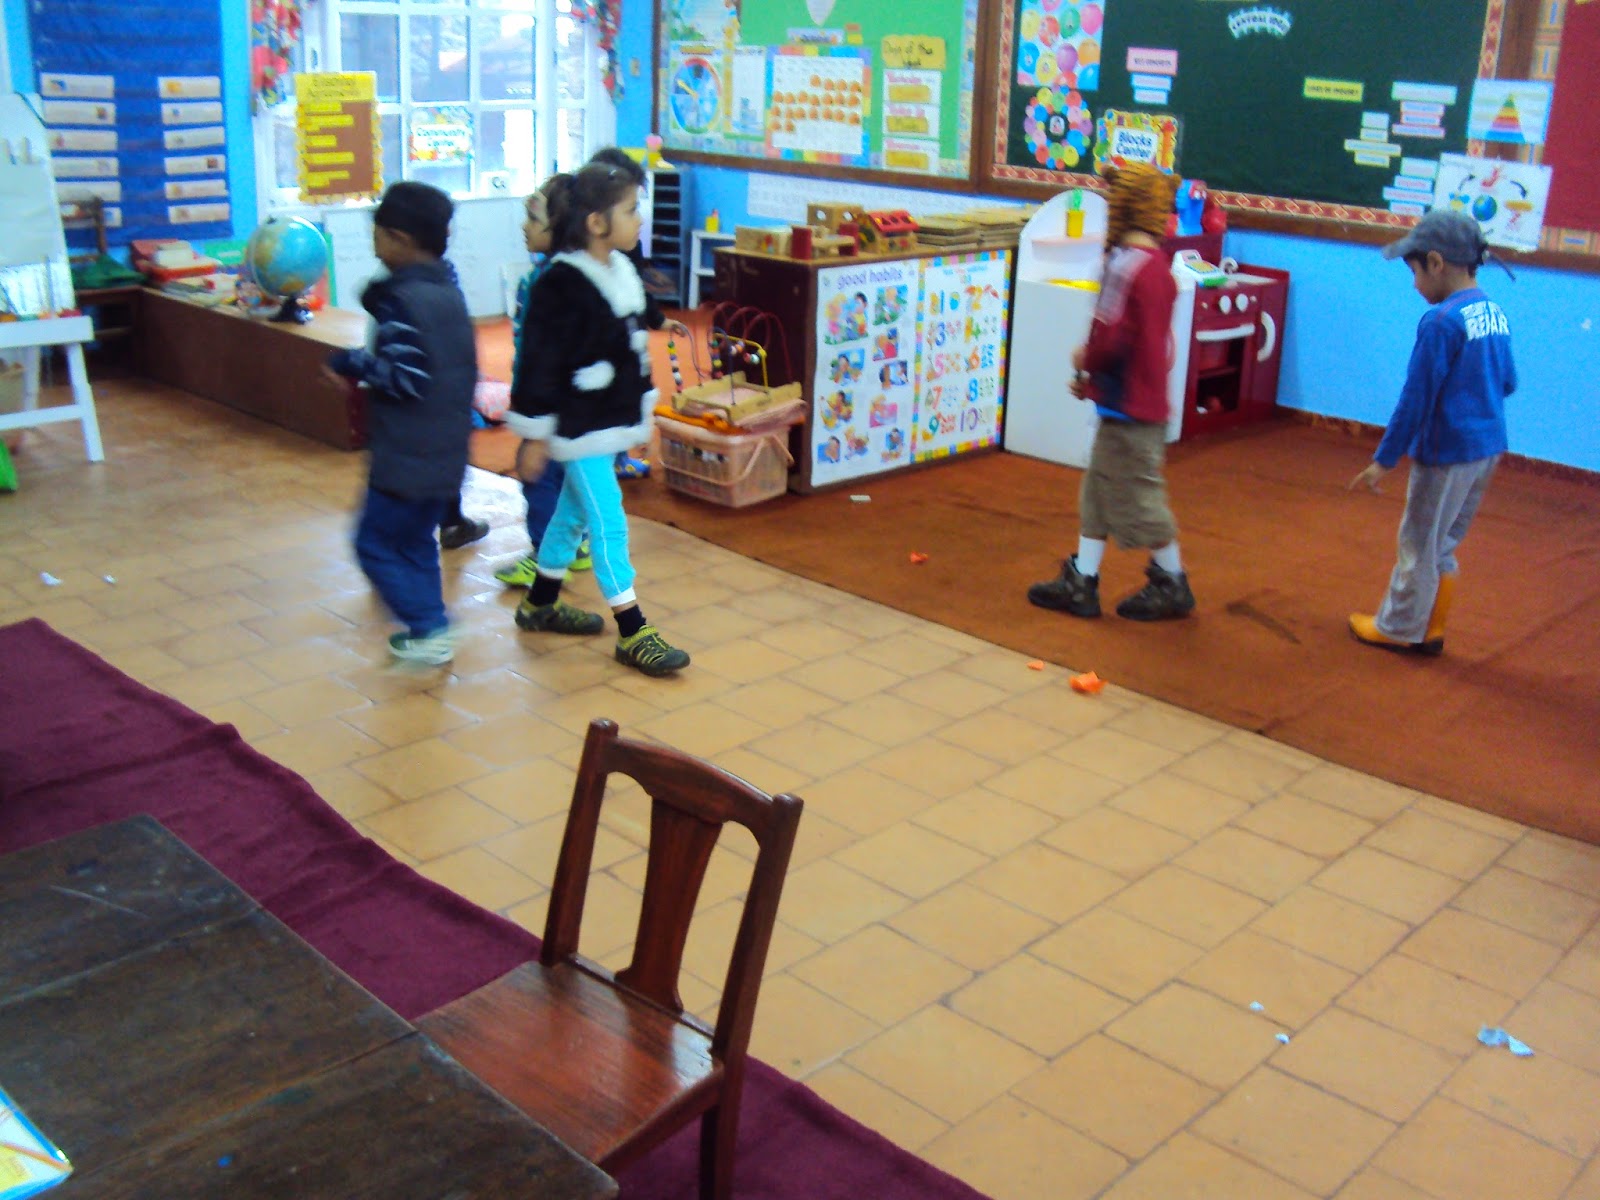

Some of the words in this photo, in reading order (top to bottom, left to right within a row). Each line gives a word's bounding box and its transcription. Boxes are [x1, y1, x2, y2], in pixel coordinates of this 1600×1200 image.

[1119, 131, 1152, 147] Blocks
[837, 273, 867, 290] good
[869, 267, 903, 283] habits
[967, 377, 979, 402] 8
